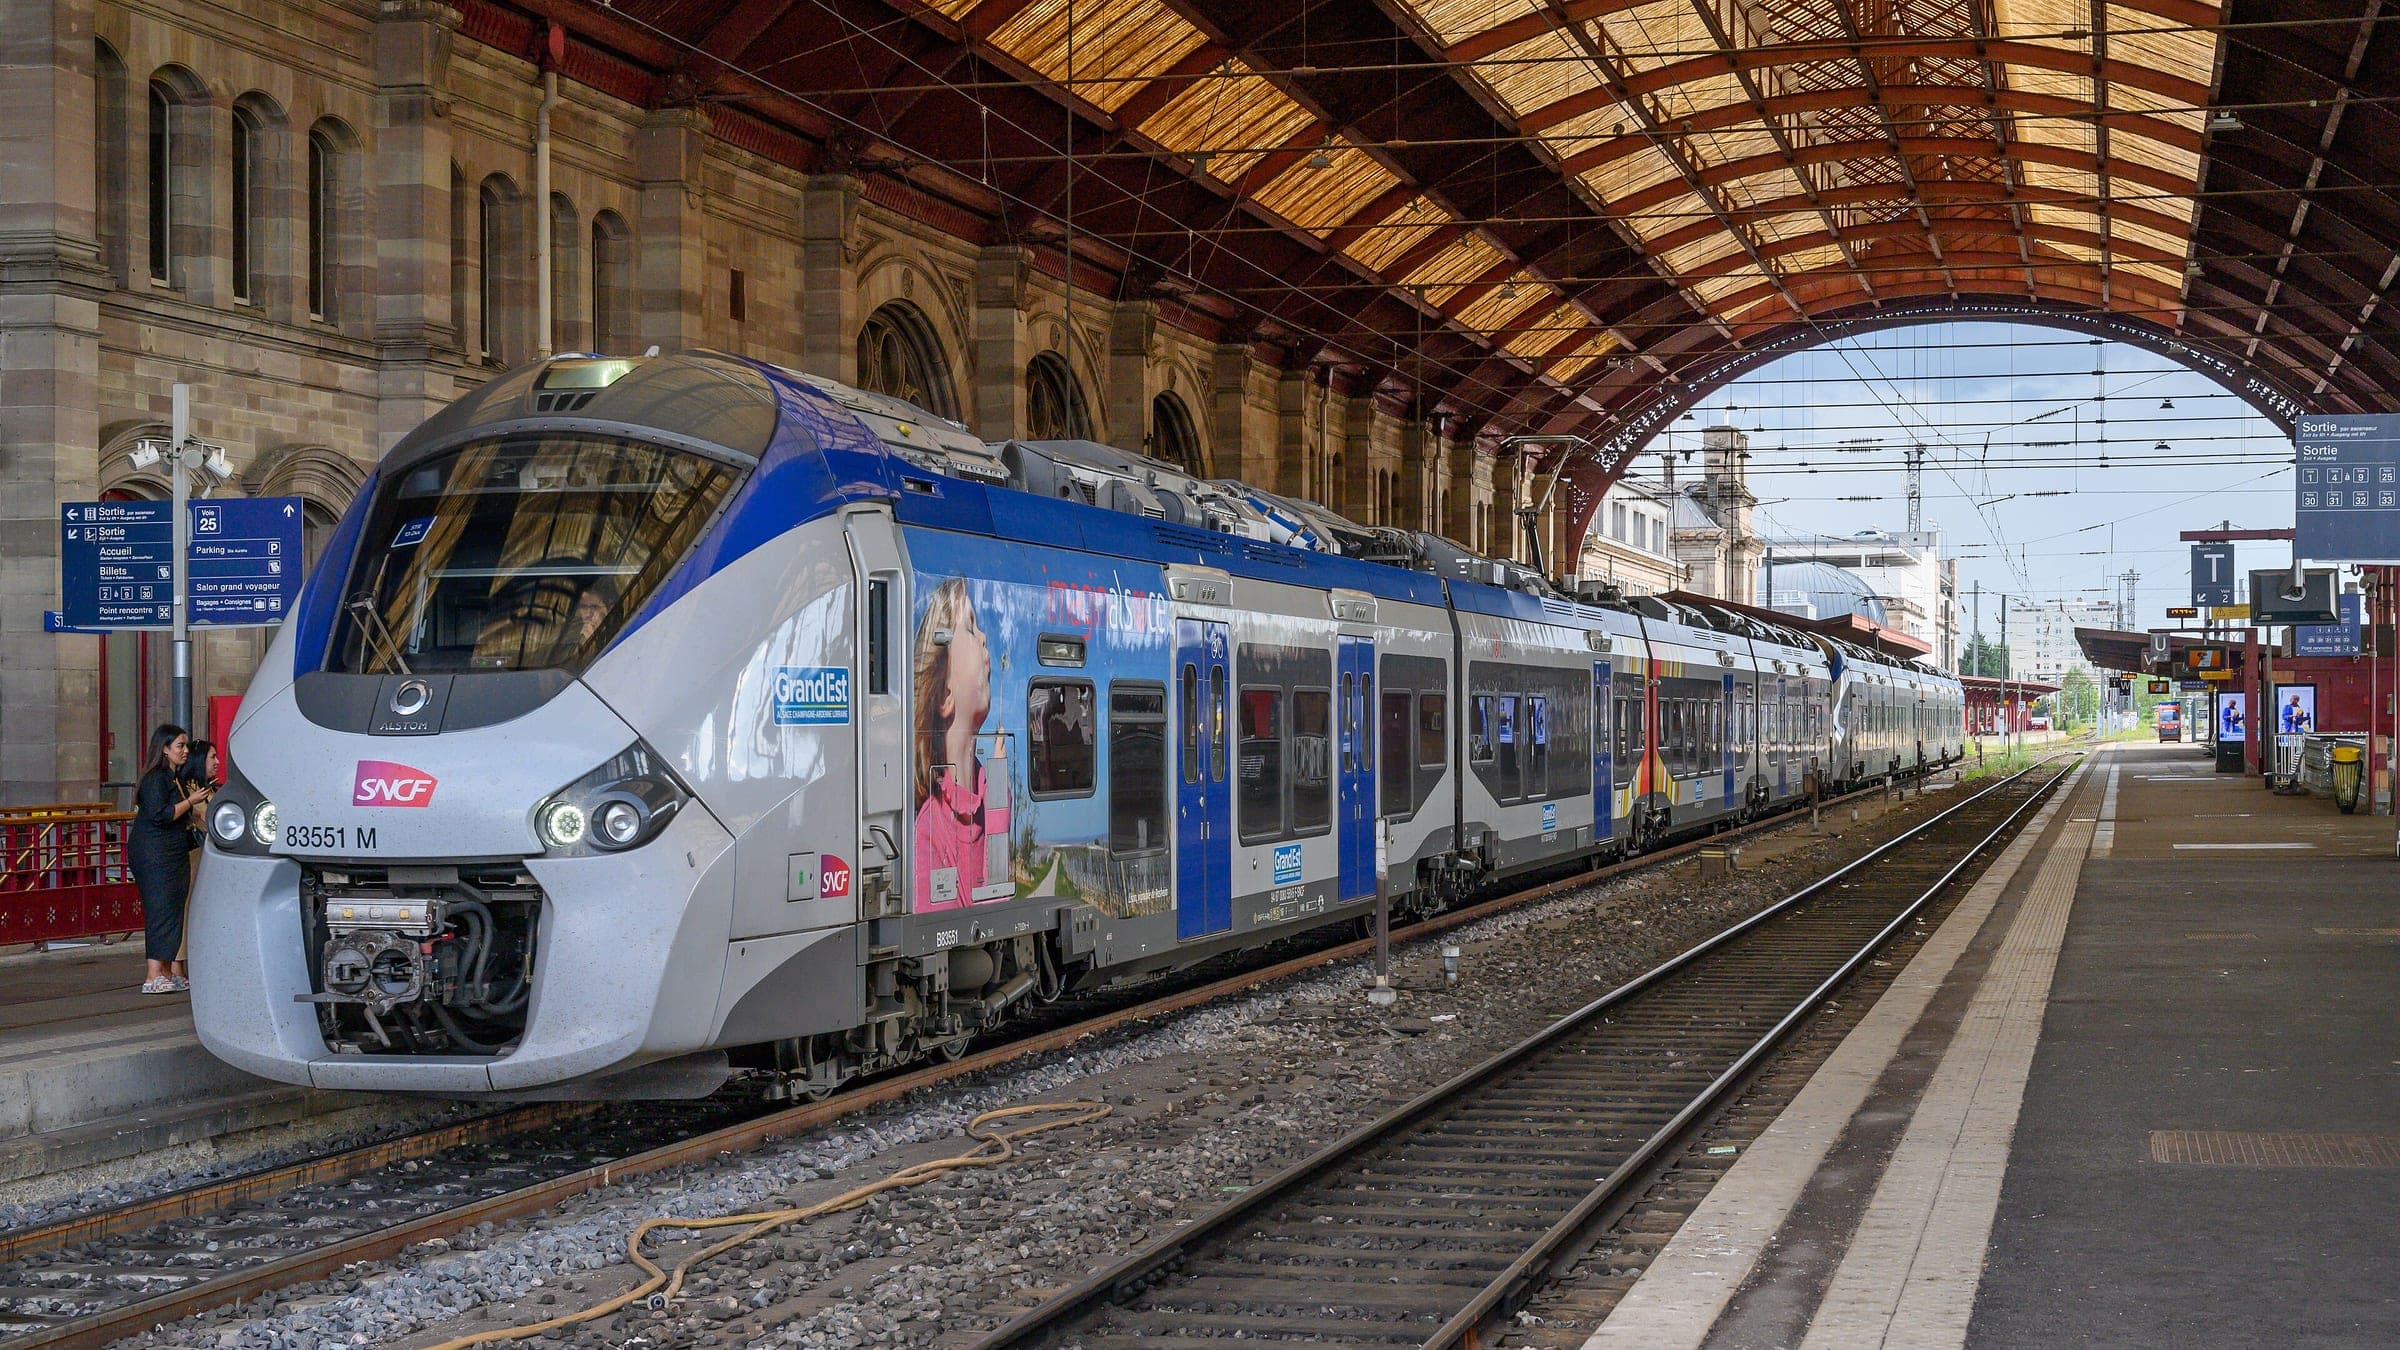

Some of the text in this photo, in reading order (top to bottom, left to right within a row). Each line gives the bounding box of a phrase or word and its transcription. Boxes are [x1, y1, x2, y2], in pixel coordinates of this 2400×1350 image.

[2302, 421, 2337, 432] Sortie
[2303, 445, 2338, 456] Sortie
[2308, 474, 2312, 482] 1
[2381, 473, 2393, 481] 25
[2304, 496, 2393, 505] 30 31 32 33
[99, 507, 126, 516] Sortie
[200, 518, 217, 531] 25
[99, 526, 126, 536] Sortie
[100, 547, 132, 556] Accueil
[196, 547, 225, 555] Parking
[100, 567, 127, 576] Billets
[2203, 553, 2225, 583] T
[196, 583, 280, 592] Salon grand voyageur
[142, 591, 151, 599] 30
[2222, 594, 2229, 603] 2
[224, 598, 252, 606] Consignes
[99, 607, 153, 615] Point rencontre
[2155, 637, 2167, 652] U
[379, 720, 428, 731] ALSTOM
[356, 778, 432, 802] SNCF
[286, 825, 377, 849] 83551 M
[821, 870, 849, 893] SNCF
[936, 929, 959, 948] B83551
